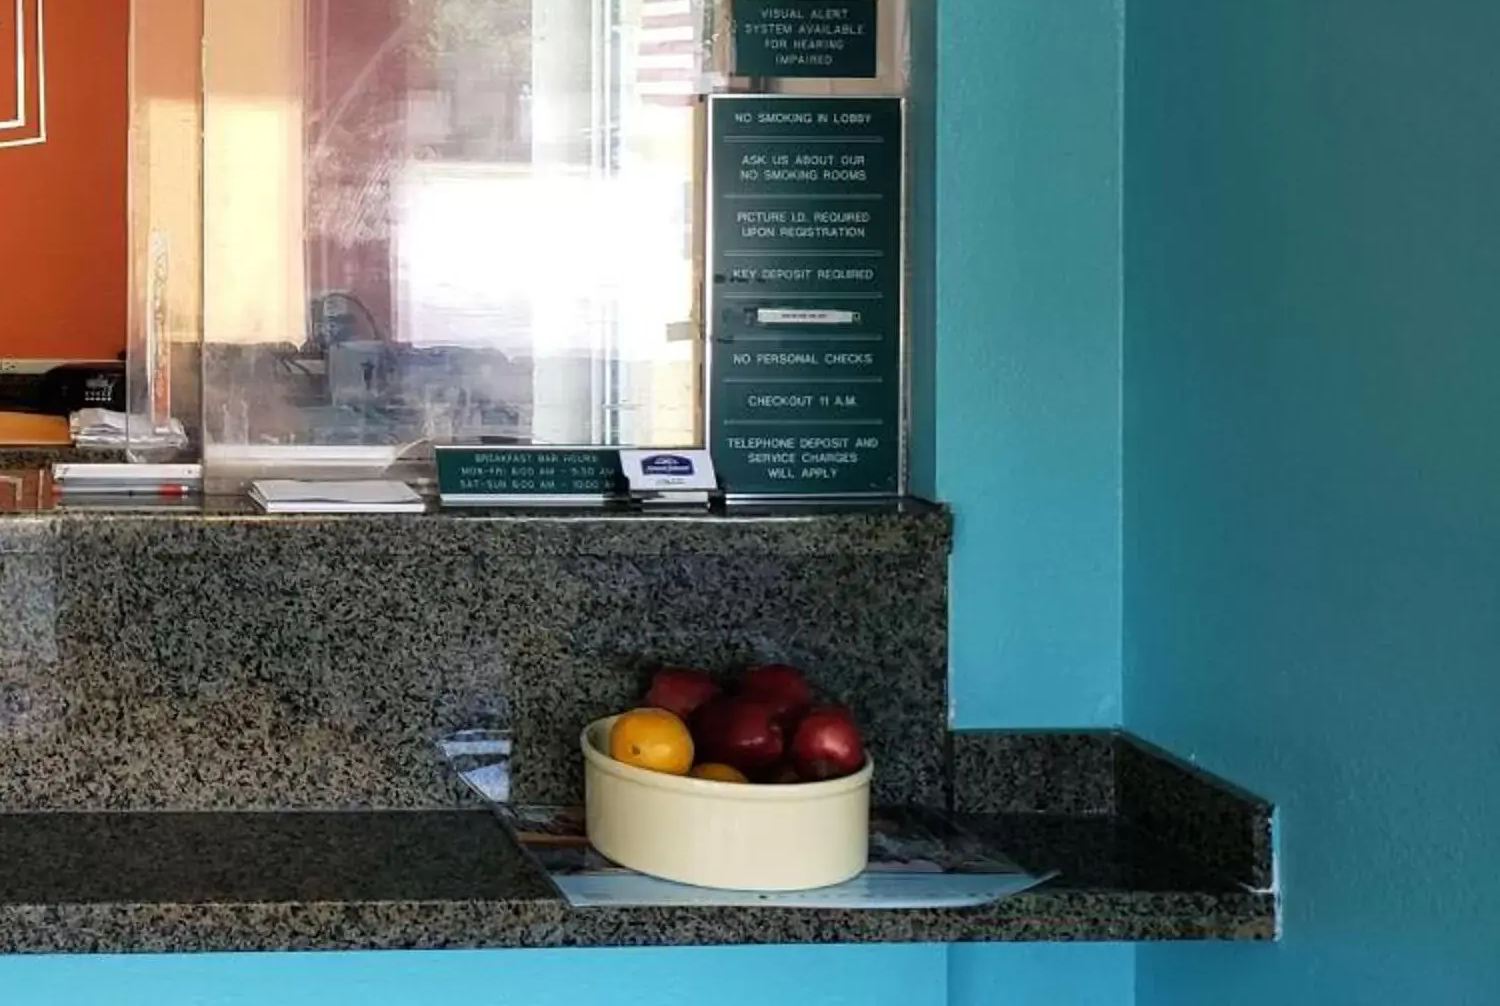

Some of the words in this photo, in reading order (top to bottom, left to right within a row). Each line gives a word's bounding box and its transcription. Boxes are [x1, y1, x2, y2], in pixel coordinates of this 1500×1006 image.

[760, 7, 804, 20] VISUAL
[810, 7, 850, 20] ALERT
[744, 23, 793, 35] SYSTEM
[799, 23, 866, 35] AVAILABLE
[763, 39, 788, 51] FOR
[792, 39, 845, 51] HEARING
[775, 54, 834, 66] IMPAIRED
[734, 112, 753, 124] NO
[757, 112, 813, 124] SMOKING
[816, 112, 829, 124] IN
[833, 112, 872, 124] LOBBY
[740, 154, 767, 166] ASK
[771, 154, 790, 166] US
[795, 154, 835, 166] ABOUT
[840, 154, 866, 166] OUR
[740, 169, 759, 181] NO
[763, 169, 818, 181] SMOKING
[823, 169, 867, 181] ROOMS
[736, 211, 787, 223] PICTURE
[813, 211, 871, 223] REQUIRED
[740, 226, 775, 237] UPON
[778, 226, 866, 237] REGISTRATION
[732, 268, 756, 280] KEY
[761, 268, 811, 280] DEPOSIT
[816, 268, 874, 280] REQUIRED
[733, 353, 752, 366] NO
[755, 353, 819, 366] PERSONAL
[823, 353, 874, 366] CHECKS
[747, 395, 813, 407] CHECKOUT
[819, 395, 830, 407] 11
[728, 437, 796, 449] TELEPHONE
[800, 437, 850, 449] DEPOSIT
[855, 437, 879, 449] AND
[747, 452, 796, 464] SERVICE
[801, 452, 858, 464] CHARGES
[766, 467, 797, 479] WILL
[801, 467, 839, 479] APPLY
